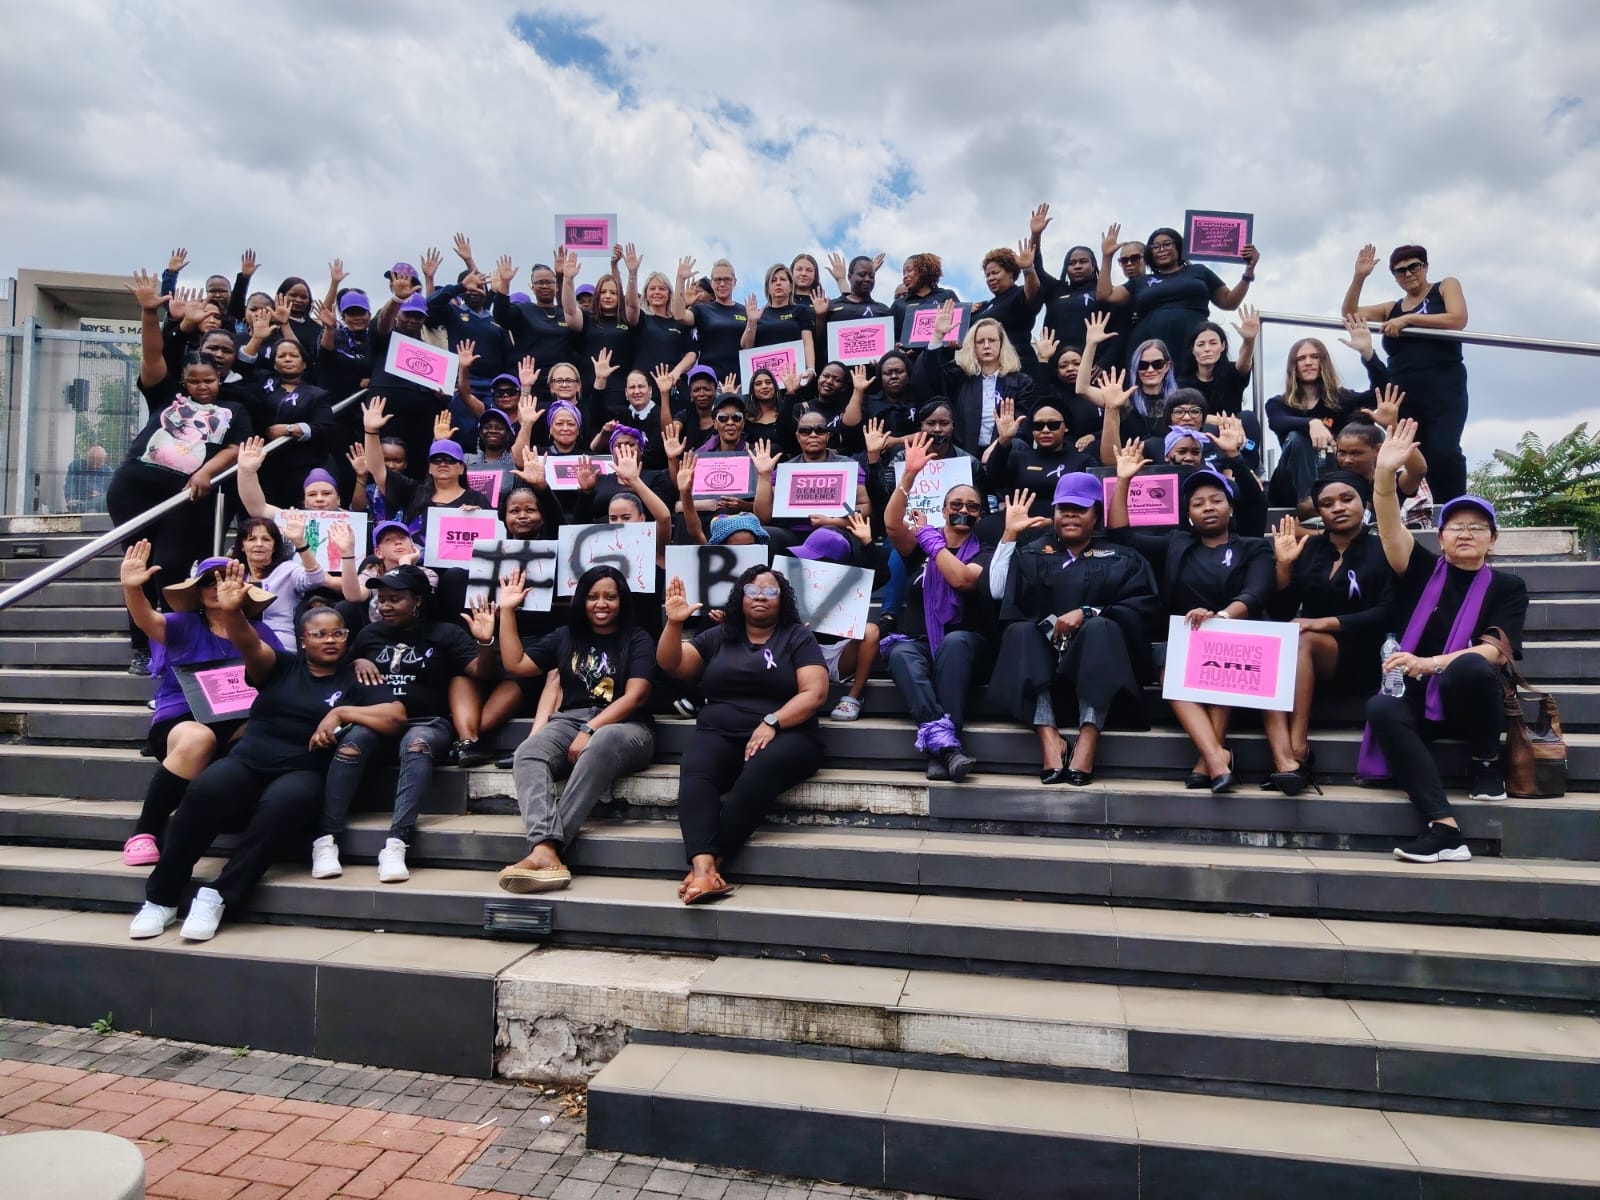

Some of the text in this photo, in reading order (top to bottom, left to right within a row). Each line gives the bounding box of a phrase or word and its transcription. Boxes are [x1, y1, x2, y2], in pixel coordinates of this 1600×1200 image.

[796, 477, 838, 488] STOP
[1129, 489, 1142, 497] NO
[446, 530, 479, 541] STOP
[697, 545, 741, 611] B
[1203, 641, 1263, 660] WOMEN'S
[1201, 660, 1262, 673] ARE
[227, 677, 240, 685] NO
[1199, 667, 1261, 686] HUMAN
